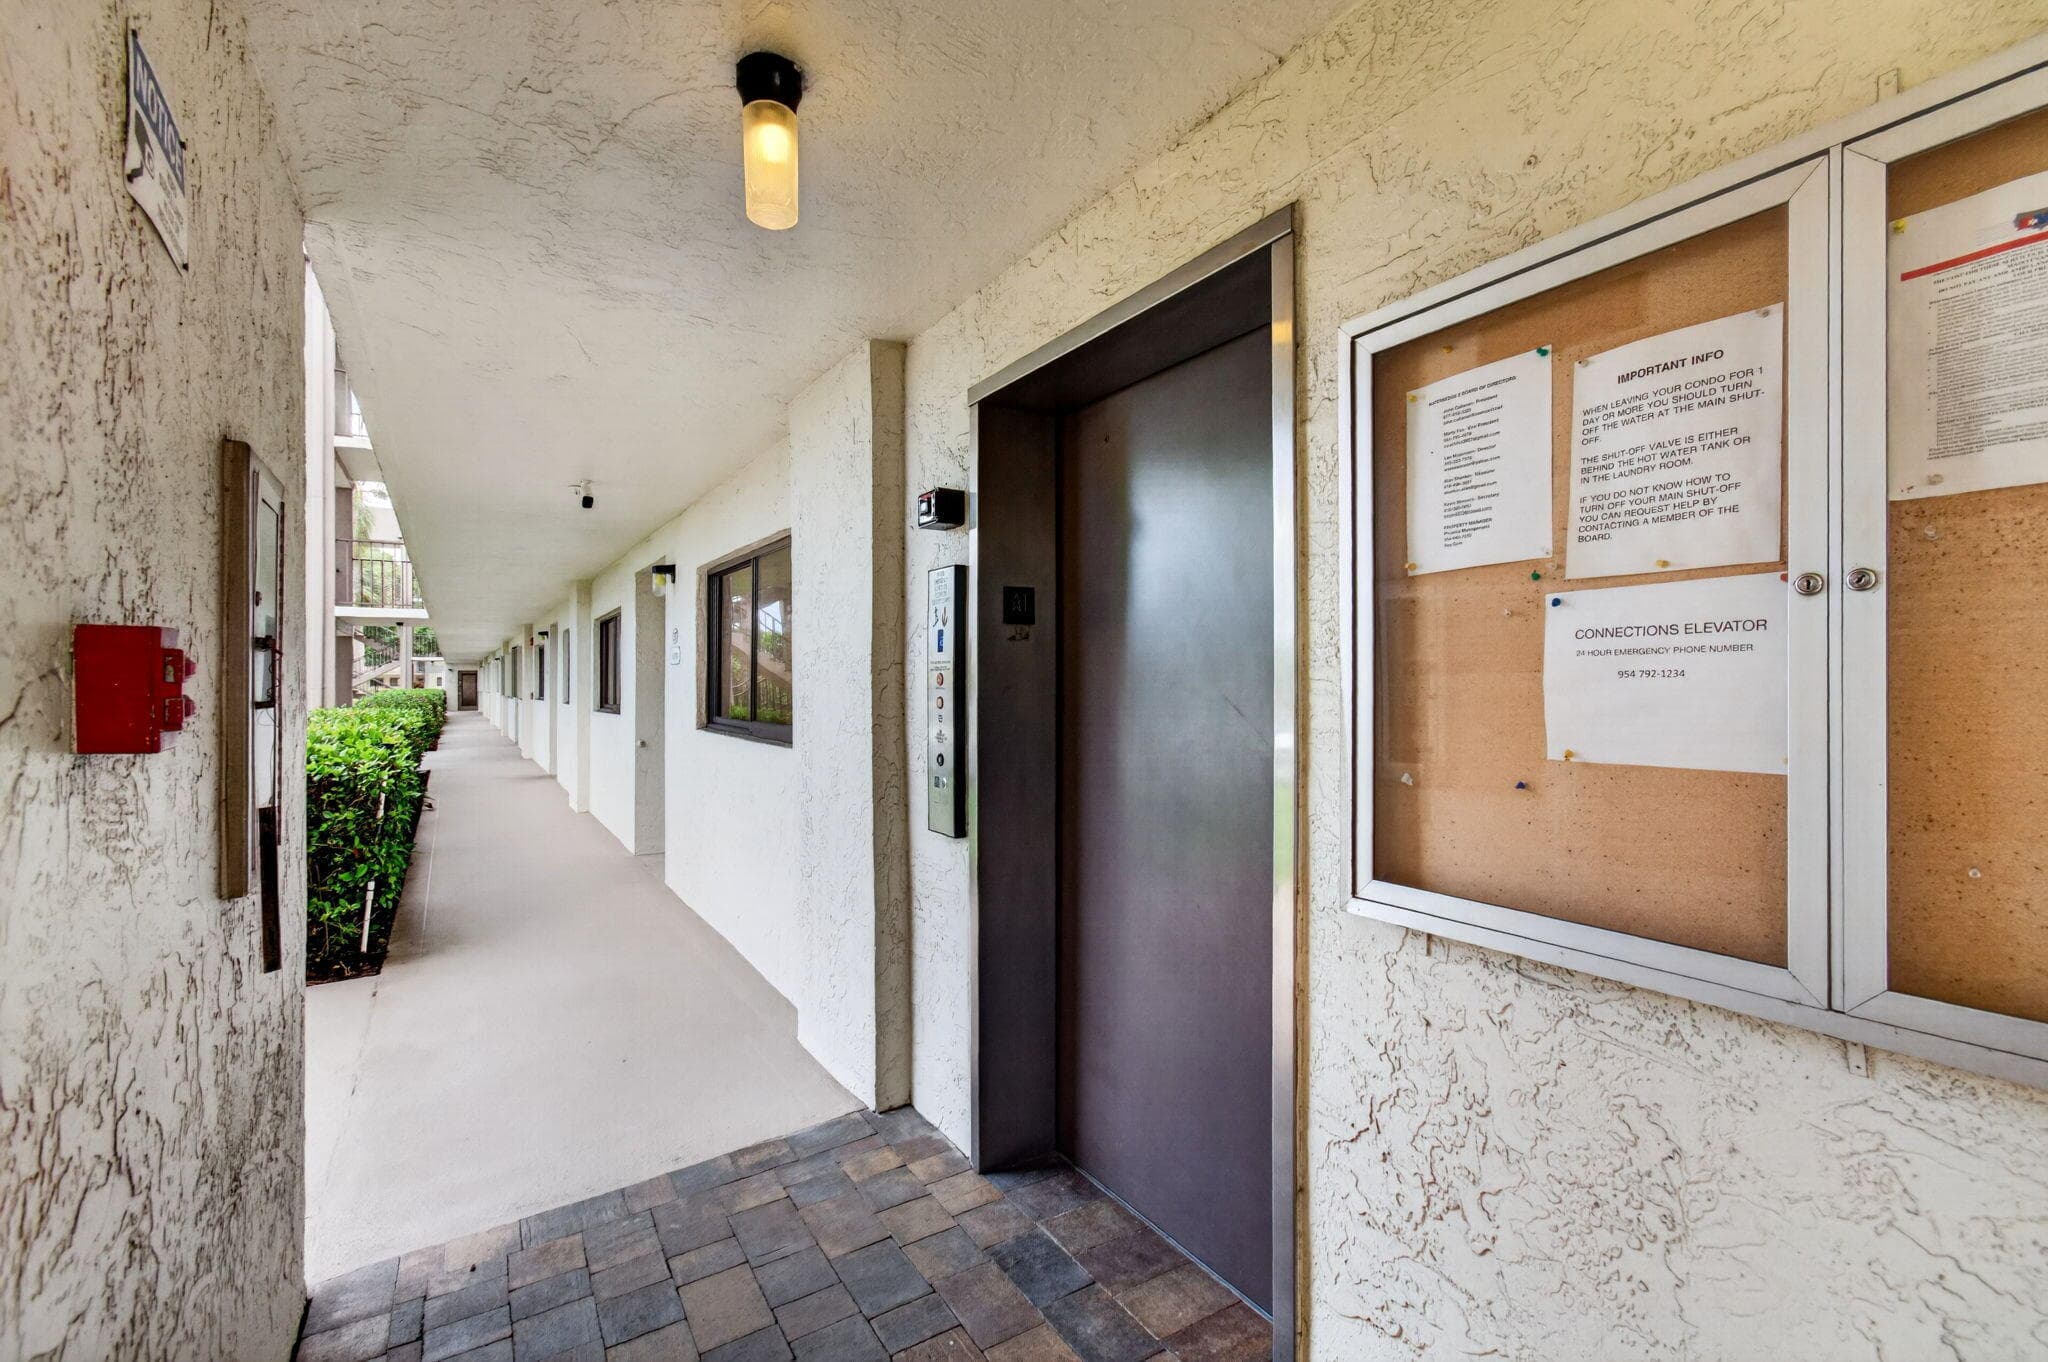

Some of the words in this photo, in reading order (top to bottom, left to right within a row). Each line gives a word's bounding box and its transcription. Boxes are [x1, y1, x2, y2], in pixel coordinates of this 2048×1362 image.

[136, 53, 183, 184] NOTICE
[1617, 357, 1686, 384] IMPORTANT
[1692, 348, 1724, 365] INFO
[1582, 415, 1599, 425] DAY
[1602, 411, 1614, 420] OR
[1617, 404, 1643, 416] MORE
[1647, 398, 1668, 409] YOU
[1672, 387, 1716, 404] SHOULD
[1720, 379, 1751, 393] TURN
[1583, 403, 1607, 416] WHEN
[1611, 392, 1648, 408] LEAVING
[1653, 384, 1681, 398] YOUR
[1685, 374, 1725, 390] CONDO
[1729, 367, 1753, 381] FOR
[1759, 366, 1762, 374] 1
[1582, 425, 1599, 435] OFF
[1601, 421, 1618, 431] THE
[1621, 412, 1654, 426] WATER
[1657, 408, 1669, 418] AT
[1675, 403, 1693, 414] THE
[1697, 396, 1725, 409] MAIN
[1729, 387, 1764, 403] SHUT-
[1580, 462, 1614, 474] BEHIND
[1618, 458, 1634, 467] THE
[1637, 453, 1656, 463] HOT
[1660, 445, 1697, 459] WATER
[1701, 439, 1729, 452] TANK
[1733, 435, 1750, 446] OR
[1581, 435, 1601, 446] OFF.
[1581, 454, 1598, 465] THE
[1601, 445, 1645, 461] SHUT-OFF
[1648, 438, 1680, 451] VALVE
[1685, 435, 1693, 444] IS
[1698, 426, 1737, 441] EITHER
[1580, 476, 1589, 485] IN
[1592, 472, 1610, 482] THE
[1613, 464, 1655, 478] LAUNDRY
[1659, 457, 1692, 470] ROOM.
[1579, 503, 1603, 514] TURN
[1607, 500, 1625, 509] OFF
[1628, 495, 1655, 506] YOUR
[1658, 491, 1683, 501] MAIN
[1686, 482, 1741, 497] SHUT-OFF
[1580, 496, 1588, 504] IF
[1590, 492, 1610, 502] YOU
[1613, 490, 1626, 498] DO
[1629, 486, 1649, 496] NOT
[1652, 480, 1682, 492] KNOW
[1686, 475, 1711, 487] HOW
[1715, 472, 1730, 482] TO
[1578, 518, 1639, 533] CONTACTING
[1642, 517, 1648, 525] A
[1651, 510, 1695, 523] MEMBER
[1698, 508, 1713, 517] OF
[1717, 504, 1739, 514] THE
[1579, 514, 1598, 523] YOU
[1601, 510, 1621, 520] CAN
[1624, 504, 1668, 517] REQUEST
[1673, 499, 1699, 510] HELP
[1703, 496, 1717, 506] BY
[1578, 531, 1612, 543] BOARD.
[1575, 623, 1678, 640] CONNECTIONS
[1684, 618, 1767, 634] ELEVATOR
[1614, 647, 1670, 655] EMERGENCY
[1673, 645, 1705, 653] PHONE
[1709, 643, 1752, 652] NUMBER
[1617, 670, 1635, 678] 954
[1639, 669, 1685, 677] 792-1234
